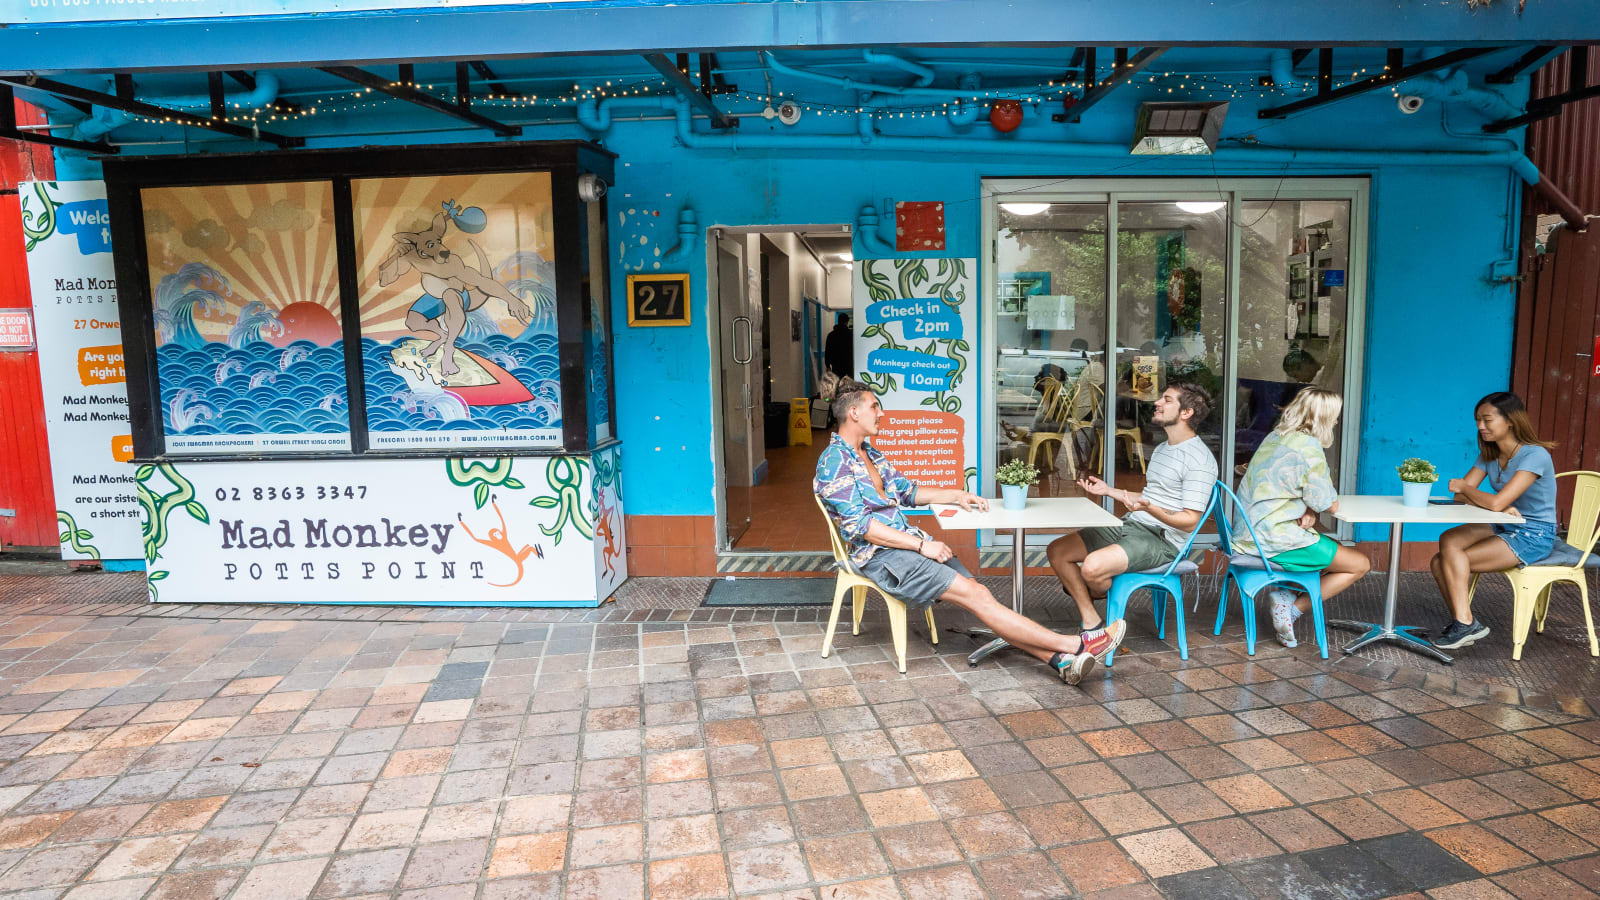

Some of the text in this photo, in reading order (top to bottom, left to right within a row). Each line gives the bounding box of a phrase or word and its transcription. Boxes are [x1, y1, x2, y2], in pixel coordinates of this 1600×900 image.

[54, 278, 84, 291] Mad
[56, 296, 104, 304] POTTS
[638, 285, 680, 316] 27
[880, 302, 940, 318] Check in
[6, 316, 26, 324] DOOR
[74, 320, 86, 330] 27
[8, 326, 22, 334] NOT
[914, 318, 949, 336] 2pm
[84, 352, 105, 362] Are
[873, 358, 910, 369] Monkeys
[912, 359, 936, 368] check
[90, 367, 116, 380] right
[911, 374, 944, 386] 10am
[62, 395, 86, 405] Mad
[64, 412, 88, 422] Mad
[918, 417, 943, 426] please
[915, 428, 938, 436] pillow
[914, 448, 954, 456] reception
[72, 474, 96, 484] Mad
[216, 486, 366, 501] 02 8363 3347
[75, 496, 92, 504] are
[100, 508, 125, 518] short
[219, 518, 454, 554] Mad Monkey
[224, 561, 484, 580] POTTS POINT
